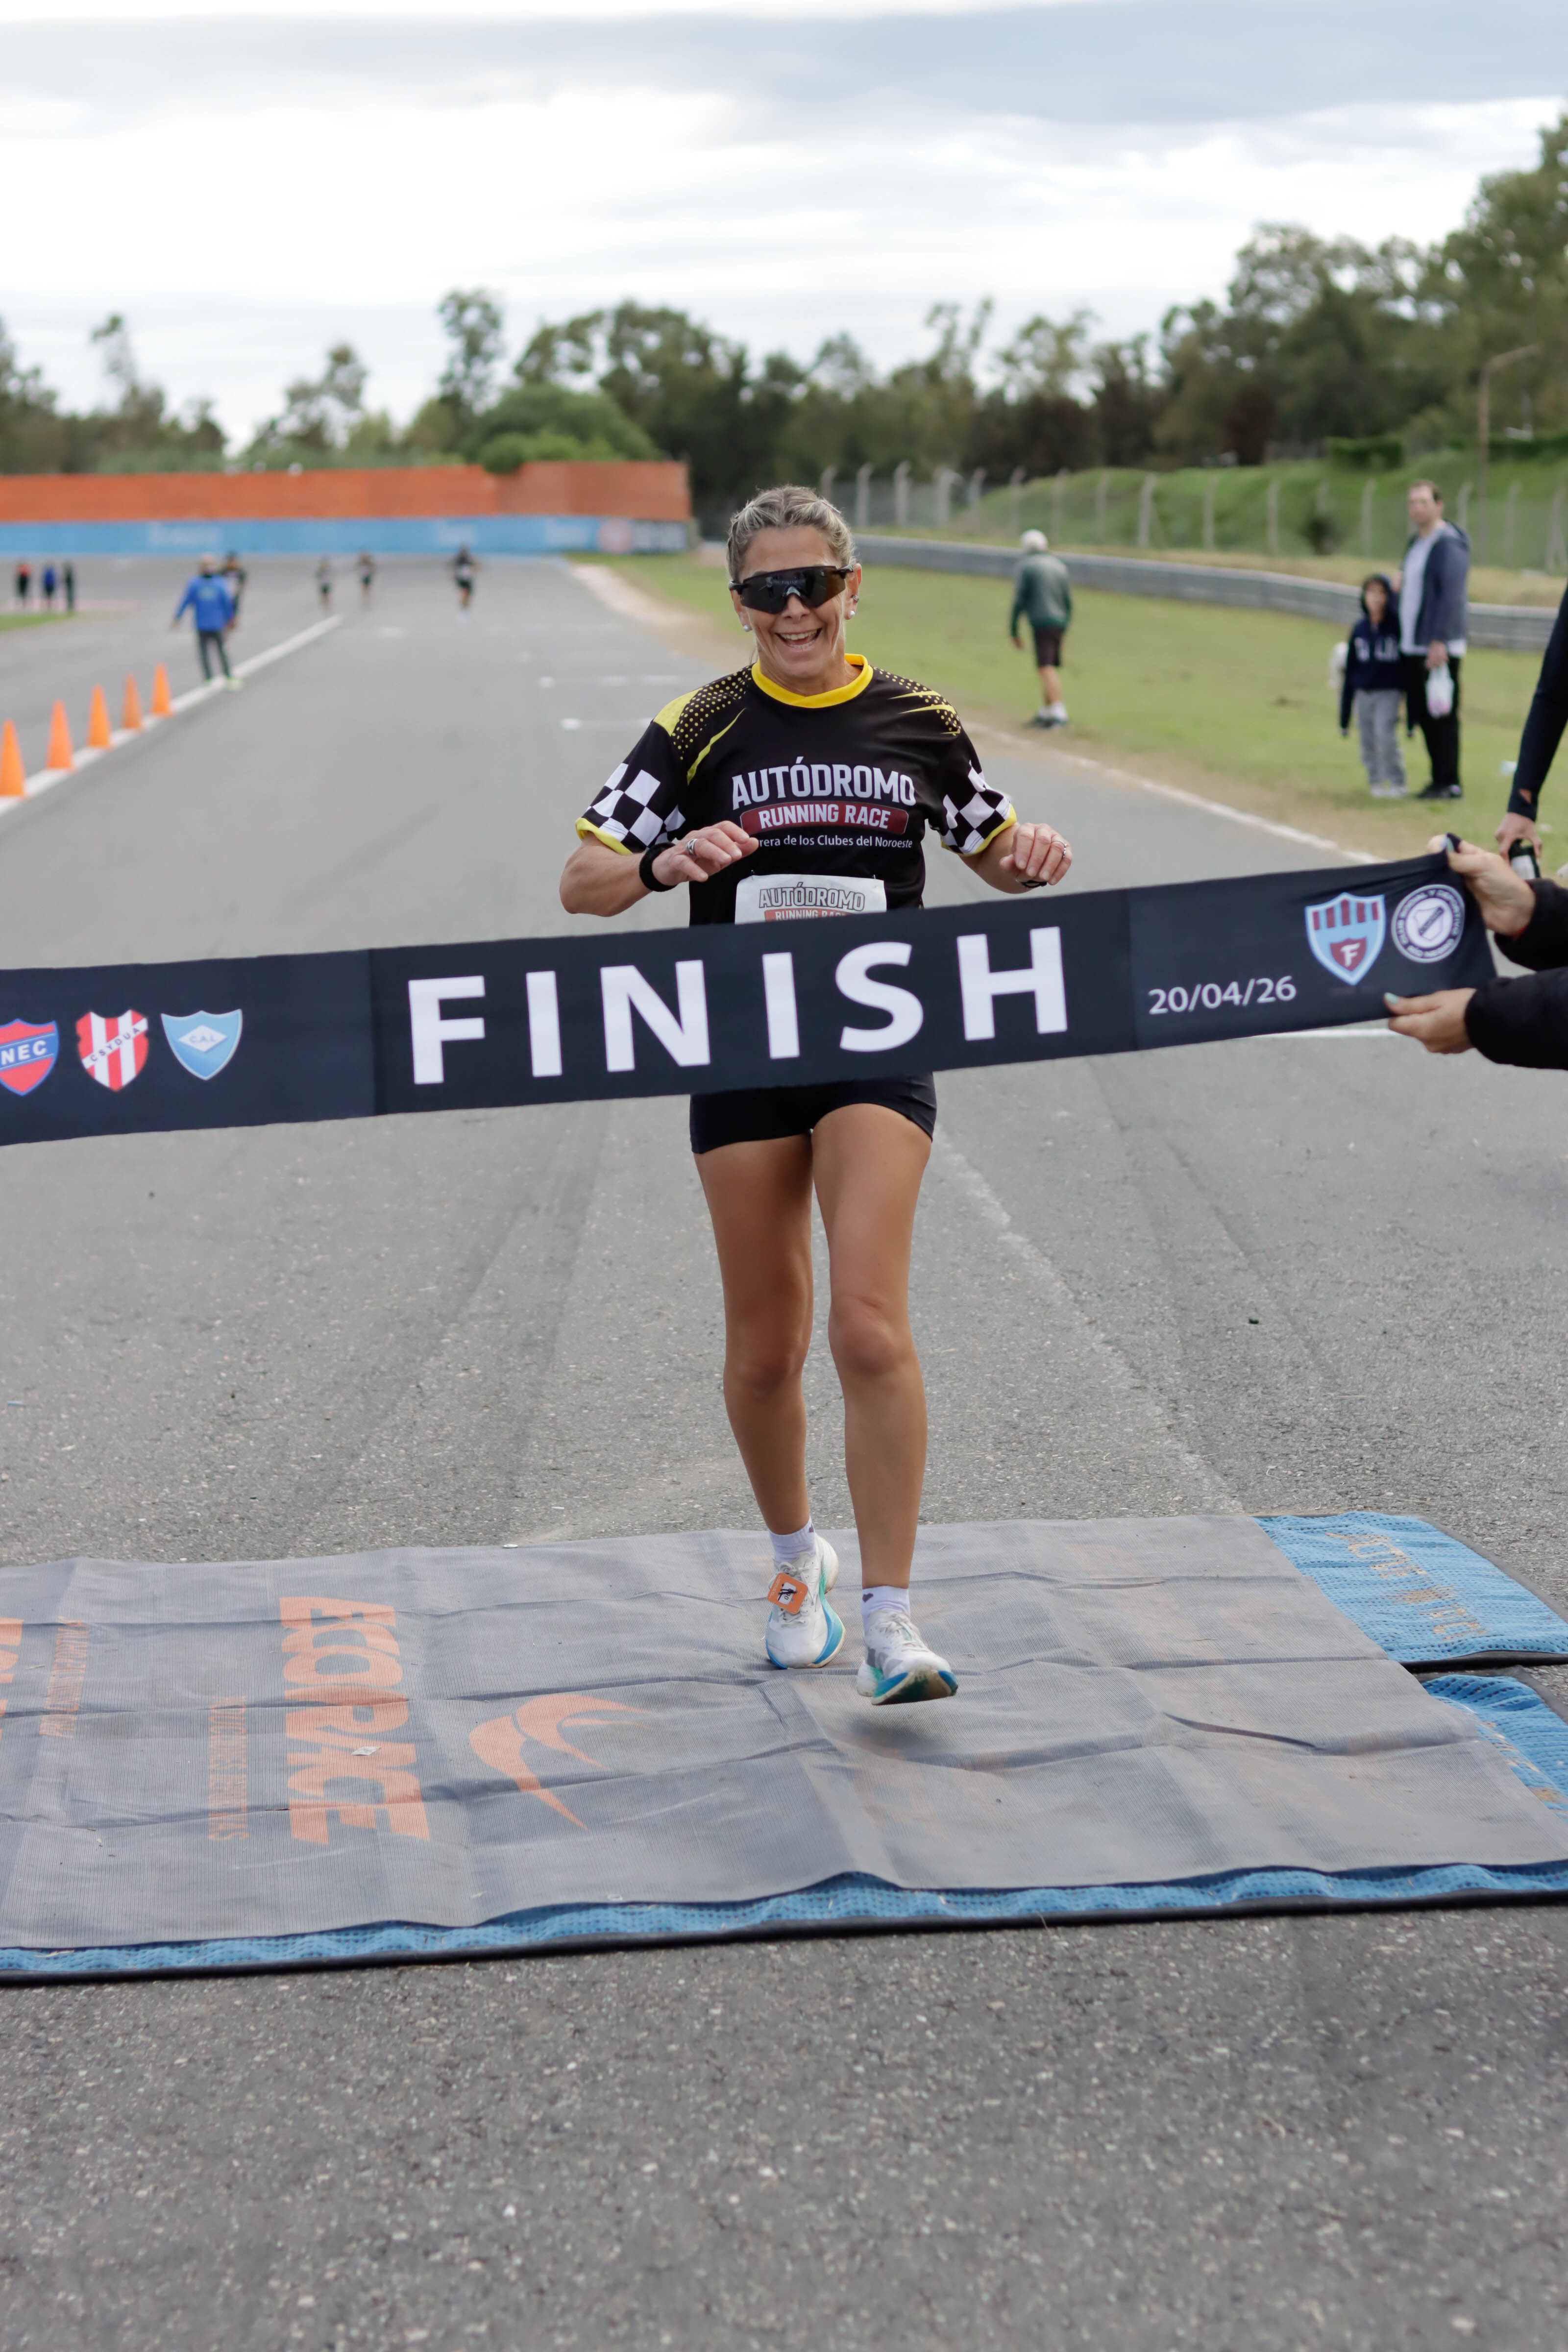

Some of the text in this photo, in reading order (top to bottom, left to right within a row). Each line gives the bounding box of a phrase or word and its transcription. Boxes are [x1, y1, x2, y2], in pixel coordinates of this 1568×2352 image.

[732, 756, 916, 810] AUTÓDROMO
[759, 804, 891, 829] RUNNING RACE
[759, 834, 913, 848] rera de los Clubes del Noroeste
[759, 882, 865, 911] AUTÓDROMO
[775, 910, 818, 921] RUNNING
[1340, 942, 1361, 967] F
[408, 927, 1068, 1086] FINISH
[1148, 975, 1297, 1015] 20/04/26
[0, 1039, 47, 1065] NEC
